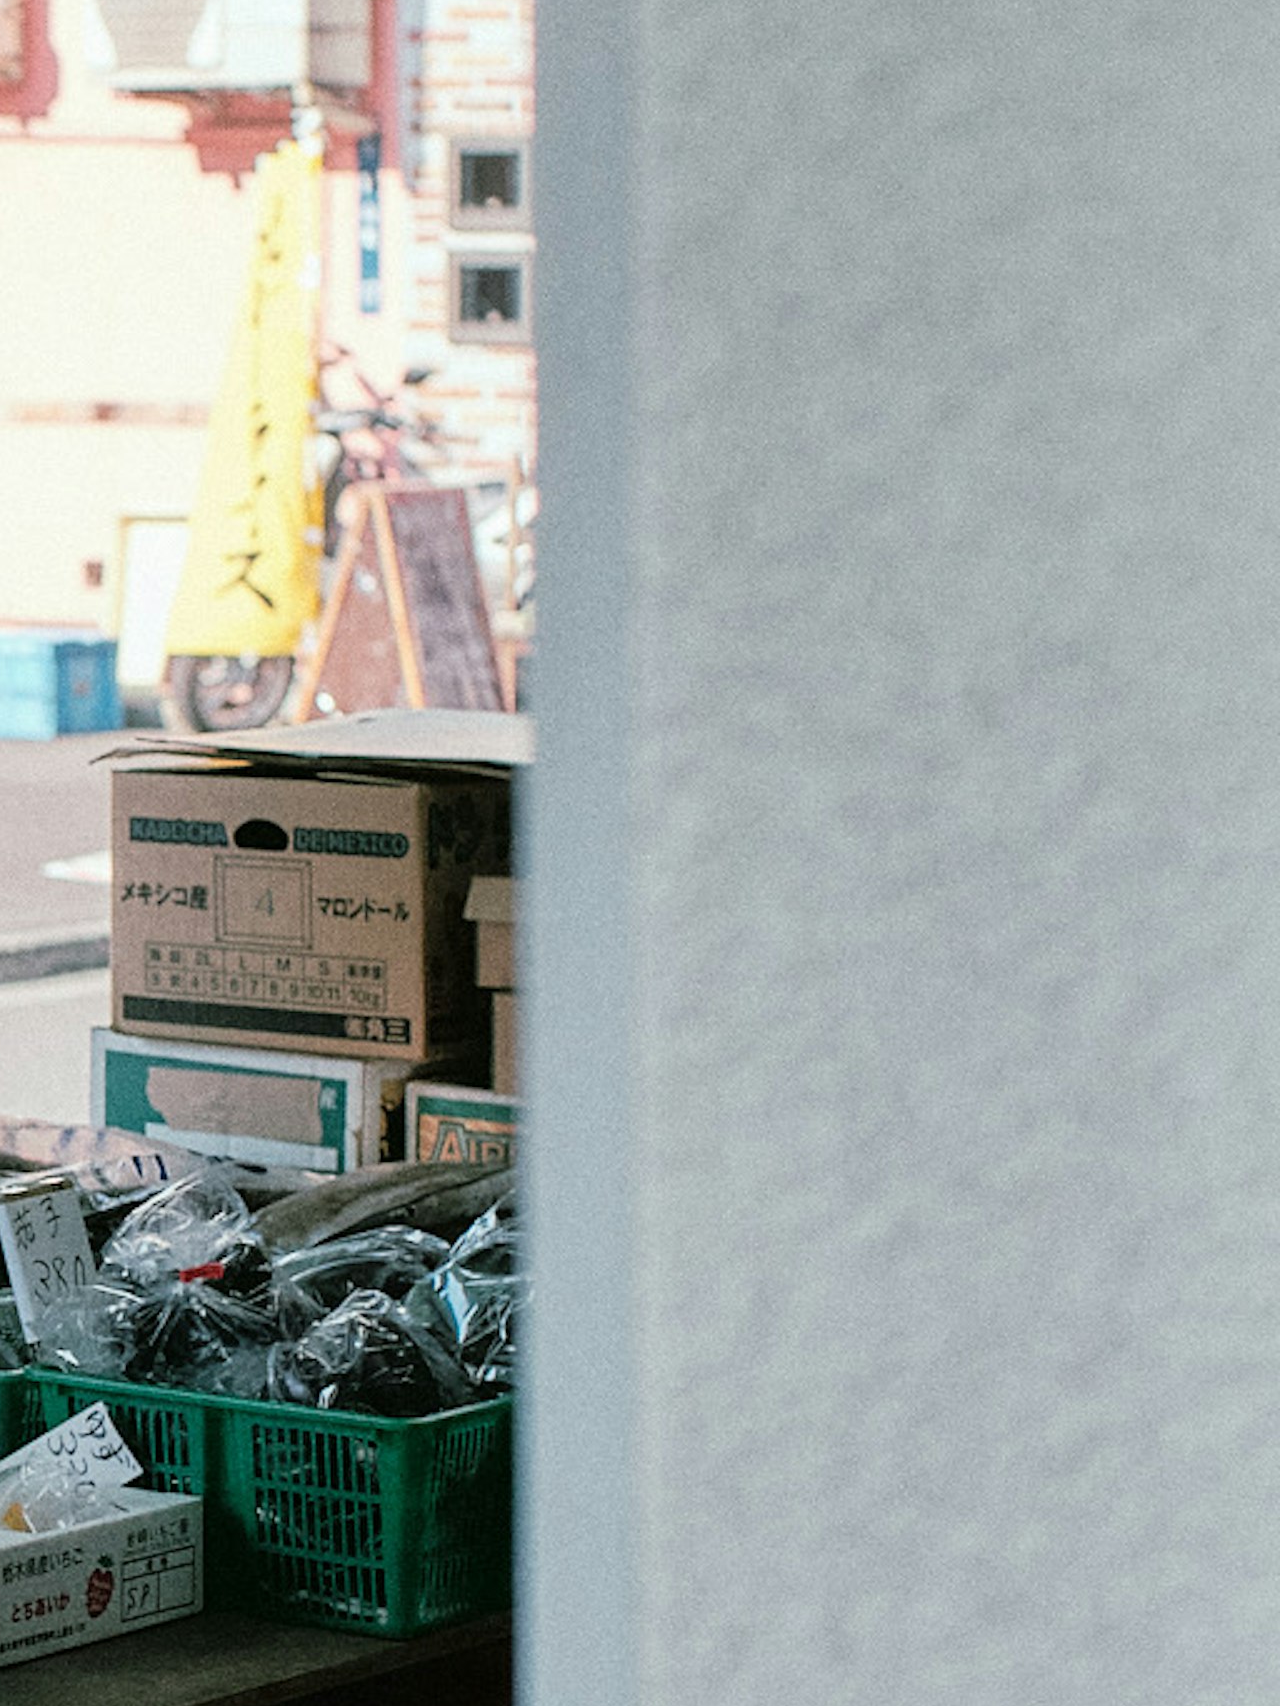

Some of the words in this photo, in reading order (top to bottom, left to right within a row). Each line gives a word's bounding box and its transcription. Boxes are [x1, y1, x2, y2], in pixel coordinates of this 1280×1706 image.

[129, 817, 228, 848] KABOCHA
[325, 830, 409, 858] MEXICO
[121, 882, 208, 910] メキシコ産
[318, 896, 409, 922] マロンドール
